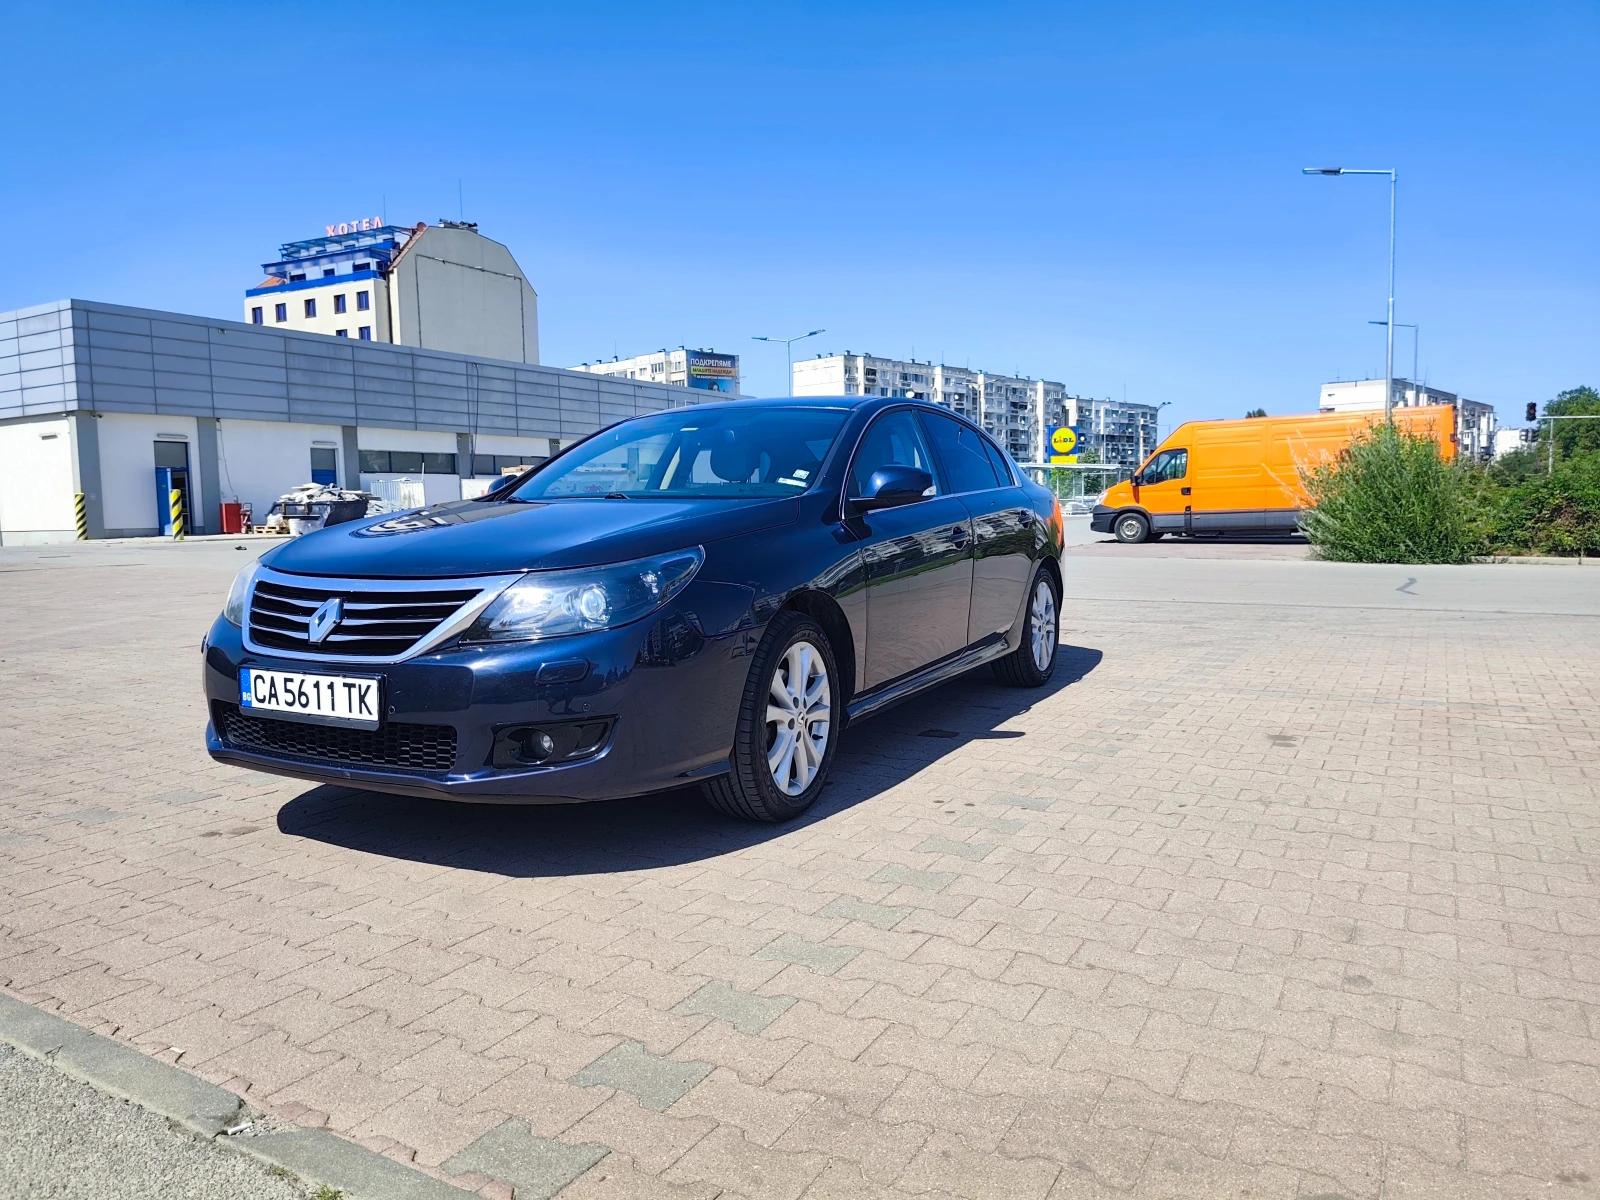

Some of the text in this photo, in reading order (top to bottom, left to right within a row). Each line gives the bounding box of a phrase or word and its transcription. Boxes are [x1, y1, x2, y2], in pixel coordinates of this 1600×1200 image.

[326, 216, 383, 237] ХОТЕЛ
[690, 358, 732, 367] ПОДКРЕПЯМЕ
[242, 691, 251, 701] BG
